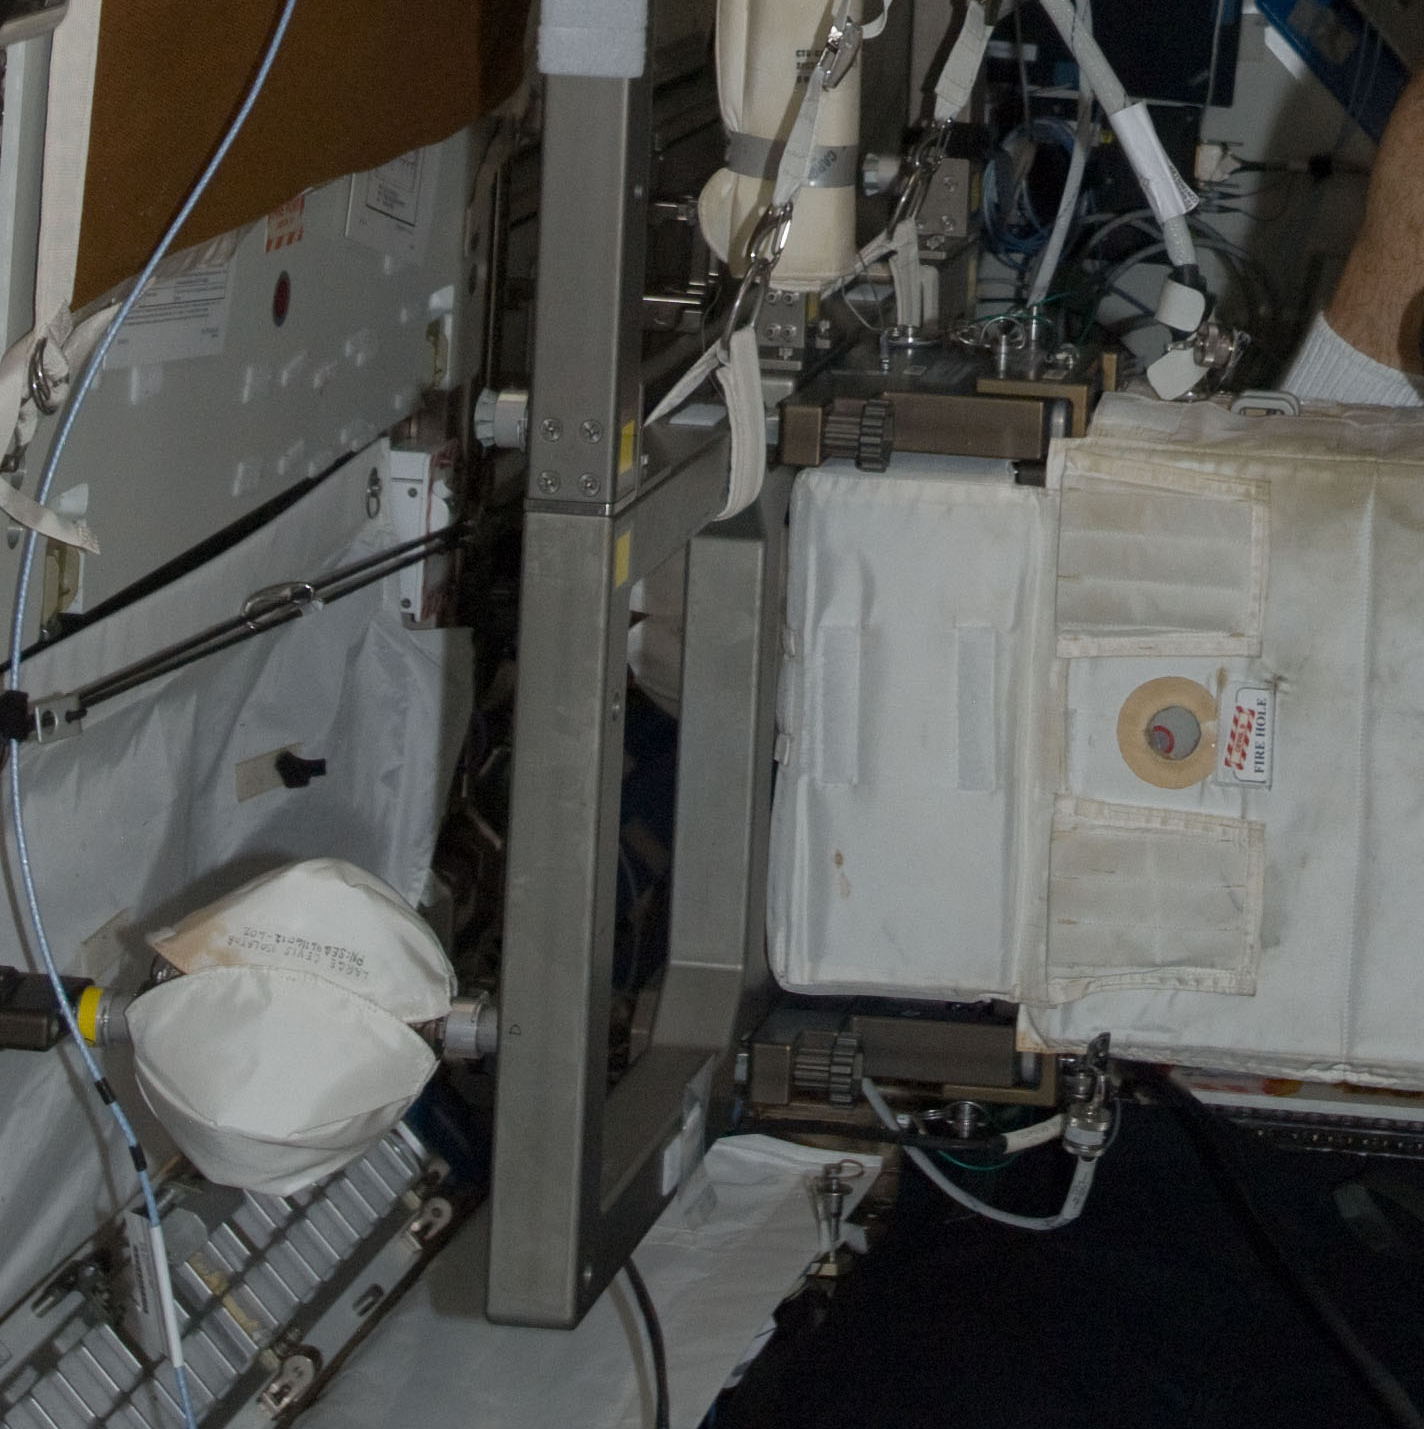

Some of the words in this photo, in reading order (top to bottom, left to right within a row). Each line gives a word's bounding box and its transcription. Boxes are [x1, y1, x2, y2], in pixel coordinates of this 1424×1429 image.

[1255, 698, 1267, 737] HOLE
[1254, 742, 1265, 773] FIRE
[329, 958, 368, 980] LARGE
